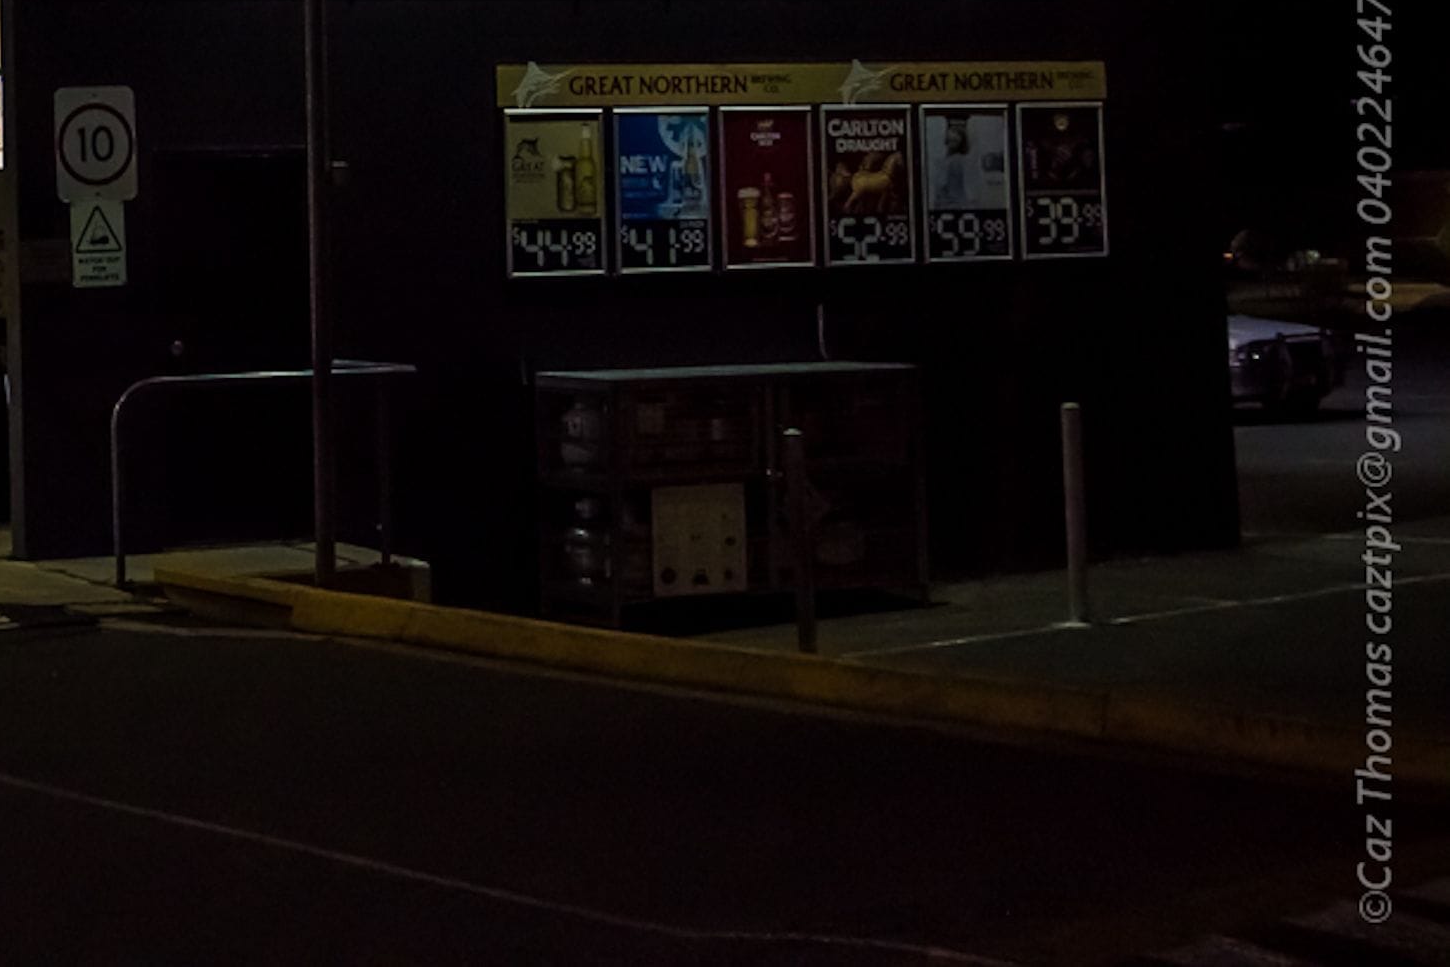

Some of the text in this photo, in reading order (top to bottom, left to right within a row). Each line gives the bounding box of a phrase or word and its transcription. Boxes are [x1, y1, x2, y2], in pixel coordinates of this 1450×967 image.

[570, 74, 748, 96] GREAT NORTHERN
[890, 71, 1054, 92] GREAT NORTHERN
[827, 118, 905, 137] CARLTON
[78, 126, 114, 162] 10
[835, 137, 900, 154] DRAUGHT
[619, 154, 668, 175] NEW
